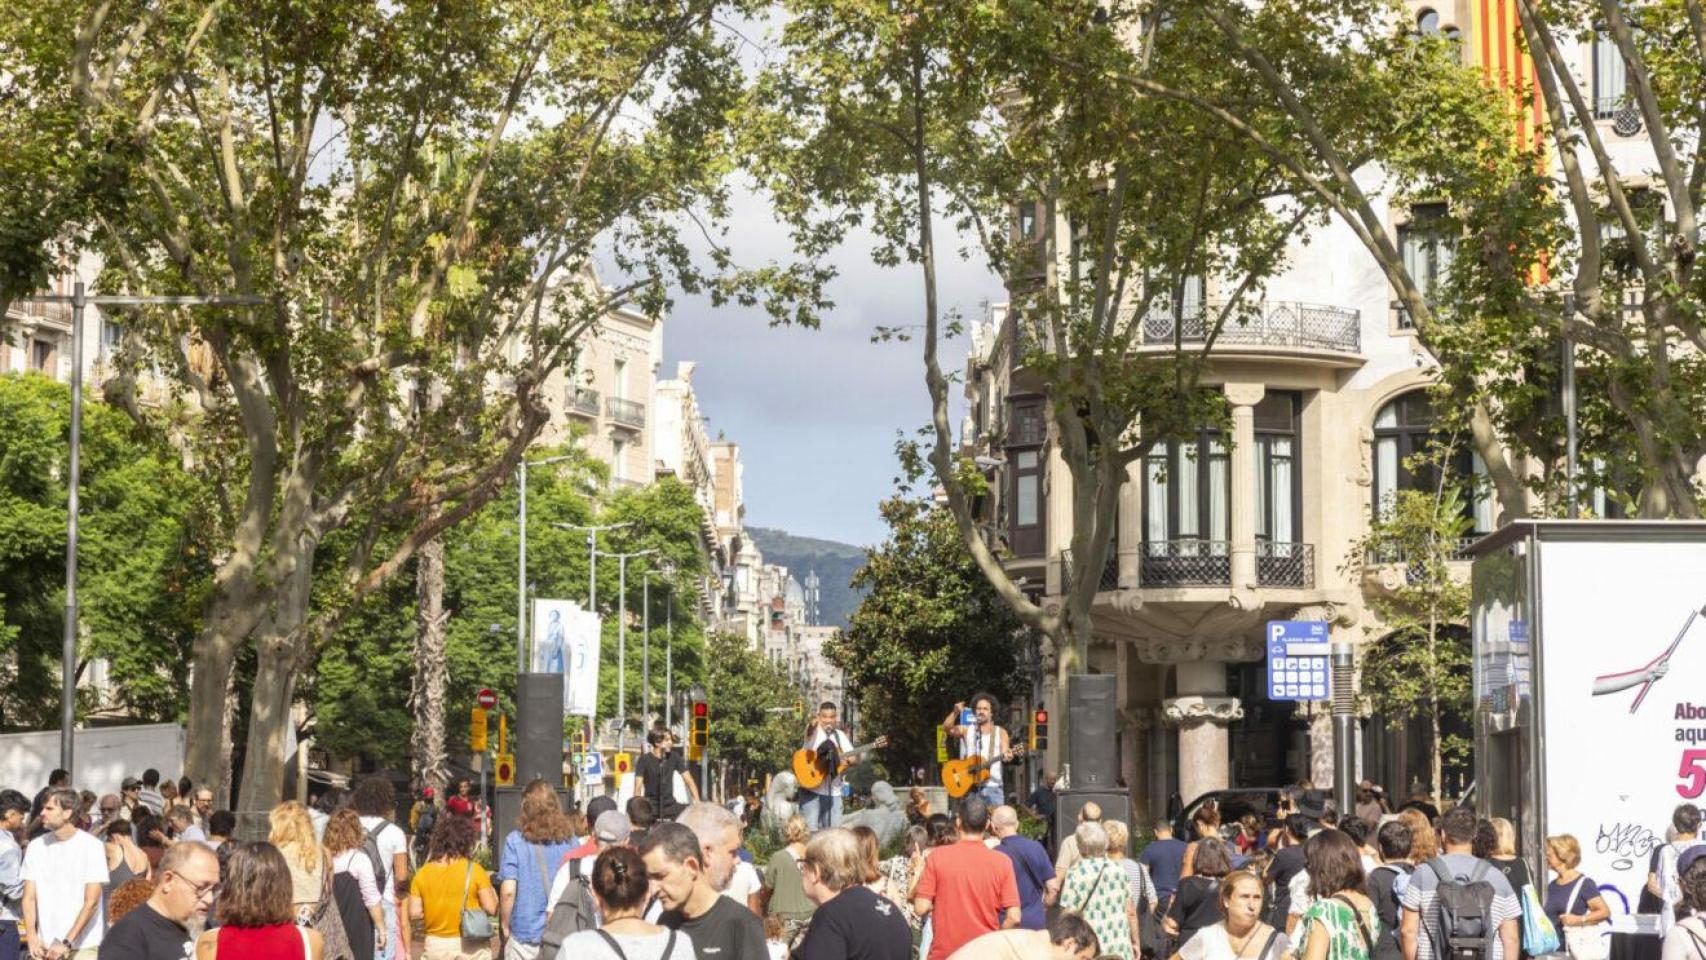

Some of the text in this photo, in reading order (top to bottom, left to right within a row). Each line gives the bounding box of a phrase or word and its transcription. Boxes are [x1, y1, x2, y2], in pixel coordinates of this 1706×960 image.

[1271, 624, 1285, 642] P
[1675, 702, 1706, 720] Abo
[1675, 728, 1706, 745] aqu
